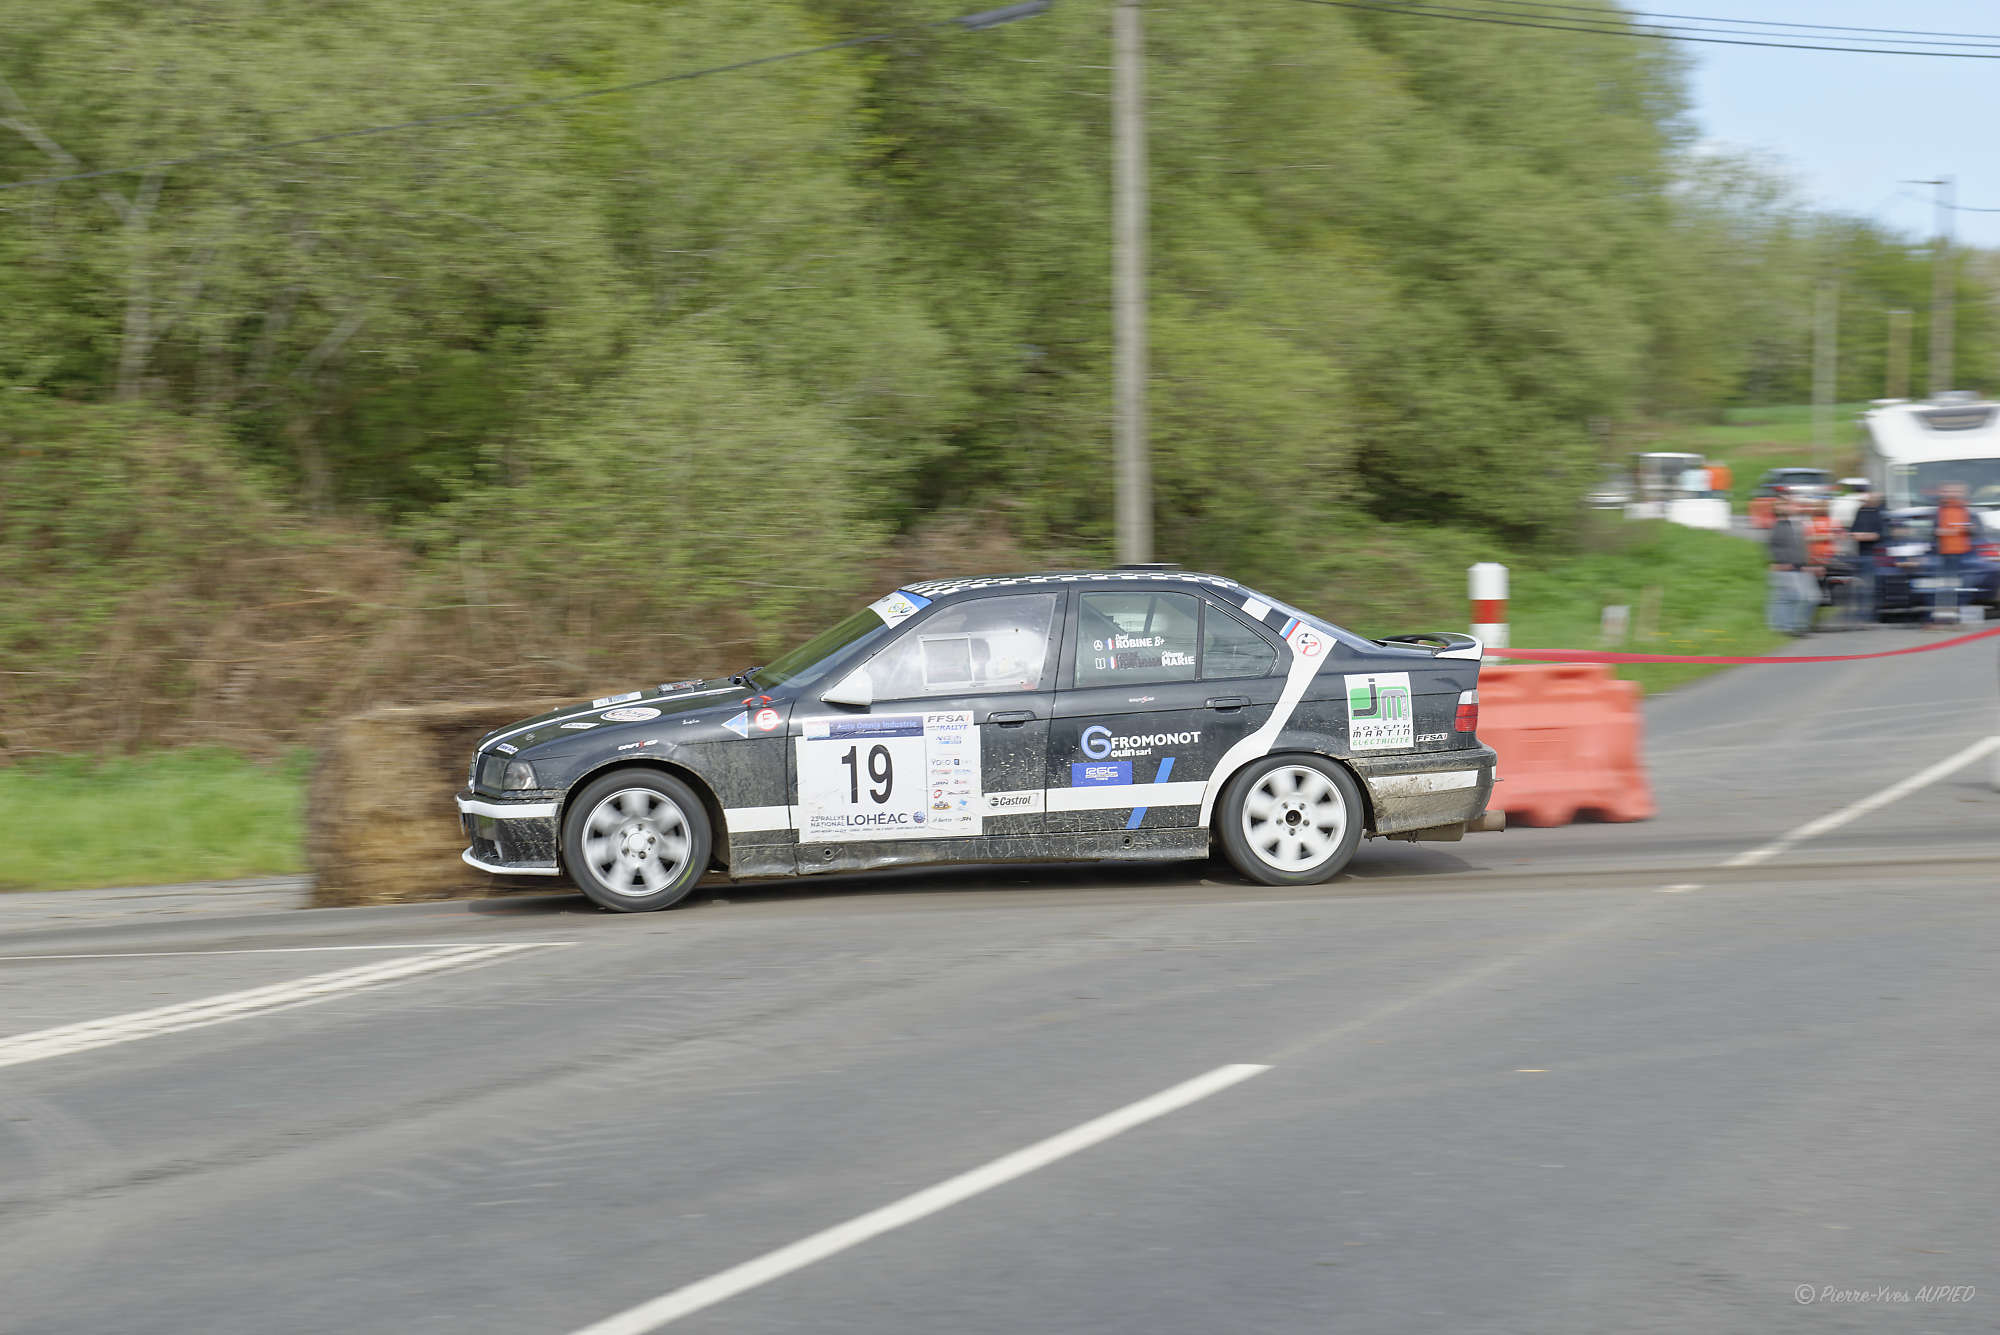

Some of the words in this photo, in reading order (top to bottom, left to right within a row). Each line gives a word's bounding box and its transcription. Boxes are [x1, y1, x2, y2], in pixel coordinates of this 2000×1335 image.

[1115, 637, 1153, 649] ROBINE
[1161, 656, 1195, 667] MARIE
[927, 714, 965, 723] FFSA
[1352, 729, 1411, 738] MARTIN
[1417, 734, 1443, 742] FFSA
[1111, 731, 1201, 749] FROMONOT
[1136, 748, 1152, 756] sarl
[841, 744, 893, 804] 19
[1000, 796, 1031, 806] Castrol
[846, 812, 908, 826] LOHÉAC
